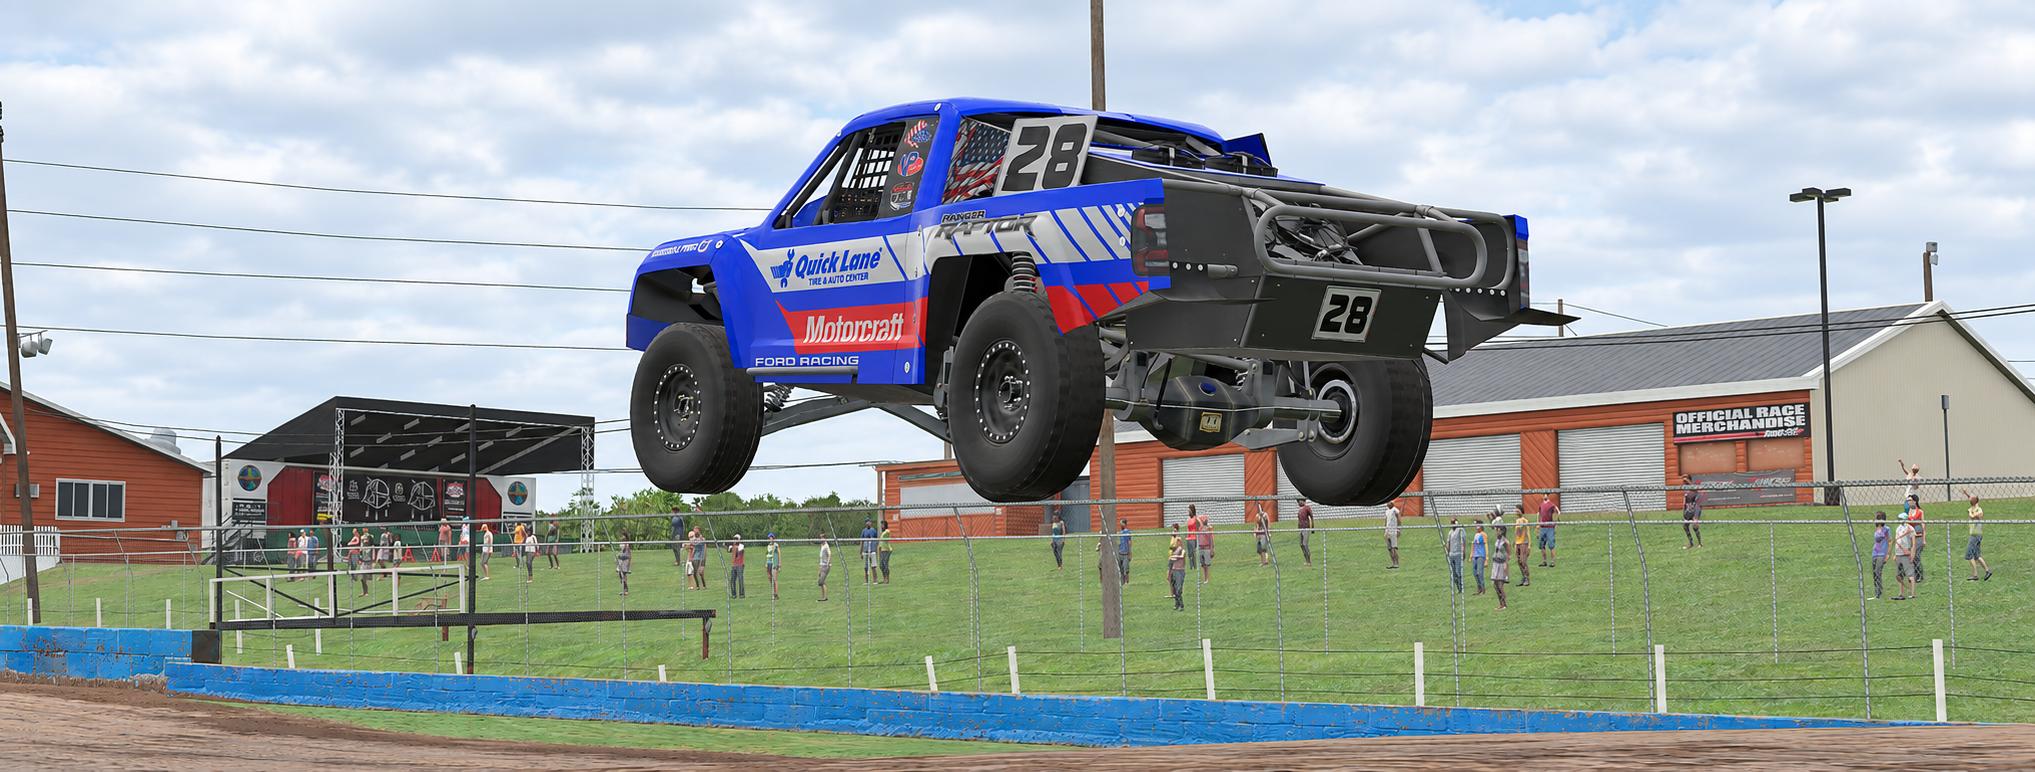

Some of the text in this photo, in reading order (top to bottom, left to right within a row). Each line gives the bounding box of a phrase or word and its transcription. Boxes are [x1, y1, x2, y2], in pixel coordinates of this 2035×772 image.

[1001, 123, 1087, 191] 28
[941, 210, 986, 222] RANGER
[933, 214, 1038, 244] RAPTOR
[795, 249, 881, 279] Quick Lane
[809, 272, 869, 286] TIRE & AUTO CENTER
[1319, 294, 1373, 334] 28
[803, 312, 904, 344] Motorcraft
[755, 355, 860, 367] FORD RACING
[1675, 415, 1806, 434] MERCHANDISE
[1676, 404, 1805, 424] OFFICIAL RACE
